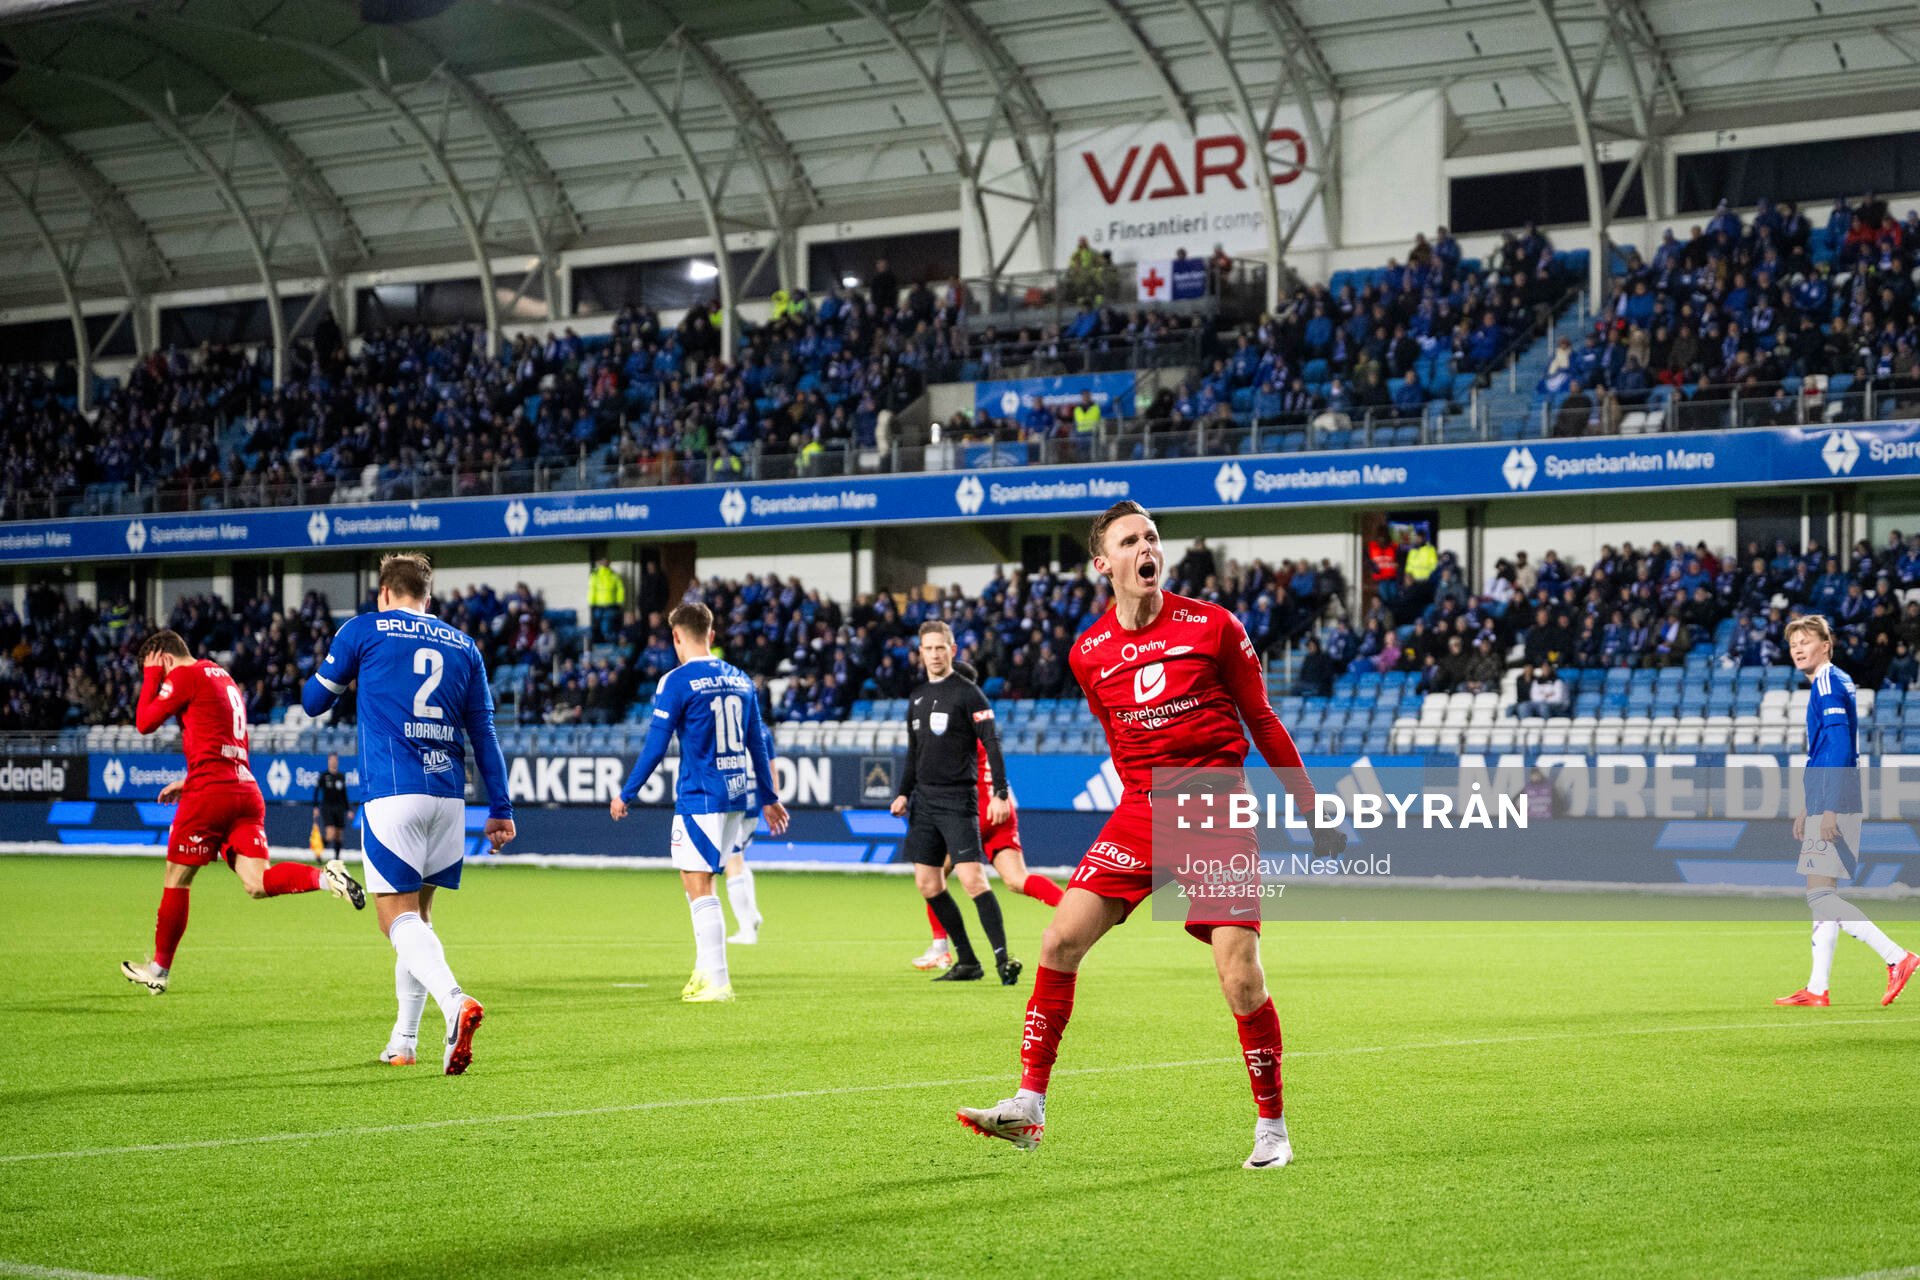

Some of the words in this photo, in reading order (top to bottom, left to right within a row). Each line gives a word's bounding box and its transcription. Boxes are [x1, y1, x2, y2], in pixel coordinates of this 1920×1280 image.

[1108, 212, 1208, 240] Fincantieri
[1212, 207, 1294, 232] compny
[1544, 452, 1663, 481] Sparebanken
[1666, 447, 1715, 471] Møre
[990, 481, 1087, 506] Sparebanken
[1089, 478, 1130, 498] Møre
[1253, 467, 1361, 493] Sparebanken
[1363, 464, 1407, 484] Møre
[534, 504, 614, 527] Sparebanken
[615, 502, 649, 520] Møre
[751, 494, 838, 517] Sparebanken
[840, 489, 877, 509] Møre
[151, 525, 218, 545] Sparebanken
[334, 515, 408, 536] Sparebanken
[409, 513, 440, 530] Møre
[1186, 614, 1208, 623] BOB
[376, 619, 470, 648] BRUNVOLL
[1092, 630, 1112, 647] BOB
[1138, 639, 1166, 653] eviny
[413, 647, 444, 720] 2
[226, 685, 246, 740] 8
[710, 695, 744, 753] 10
[404, 722, 454, 741] BJØRNBAK
[508, 757, 624, 803] AKER
[1090, 842, 1142, 868] LERØY
[1074, 865, 1098, 882] 17
[1245, 1048, 1273, 1077] ide
